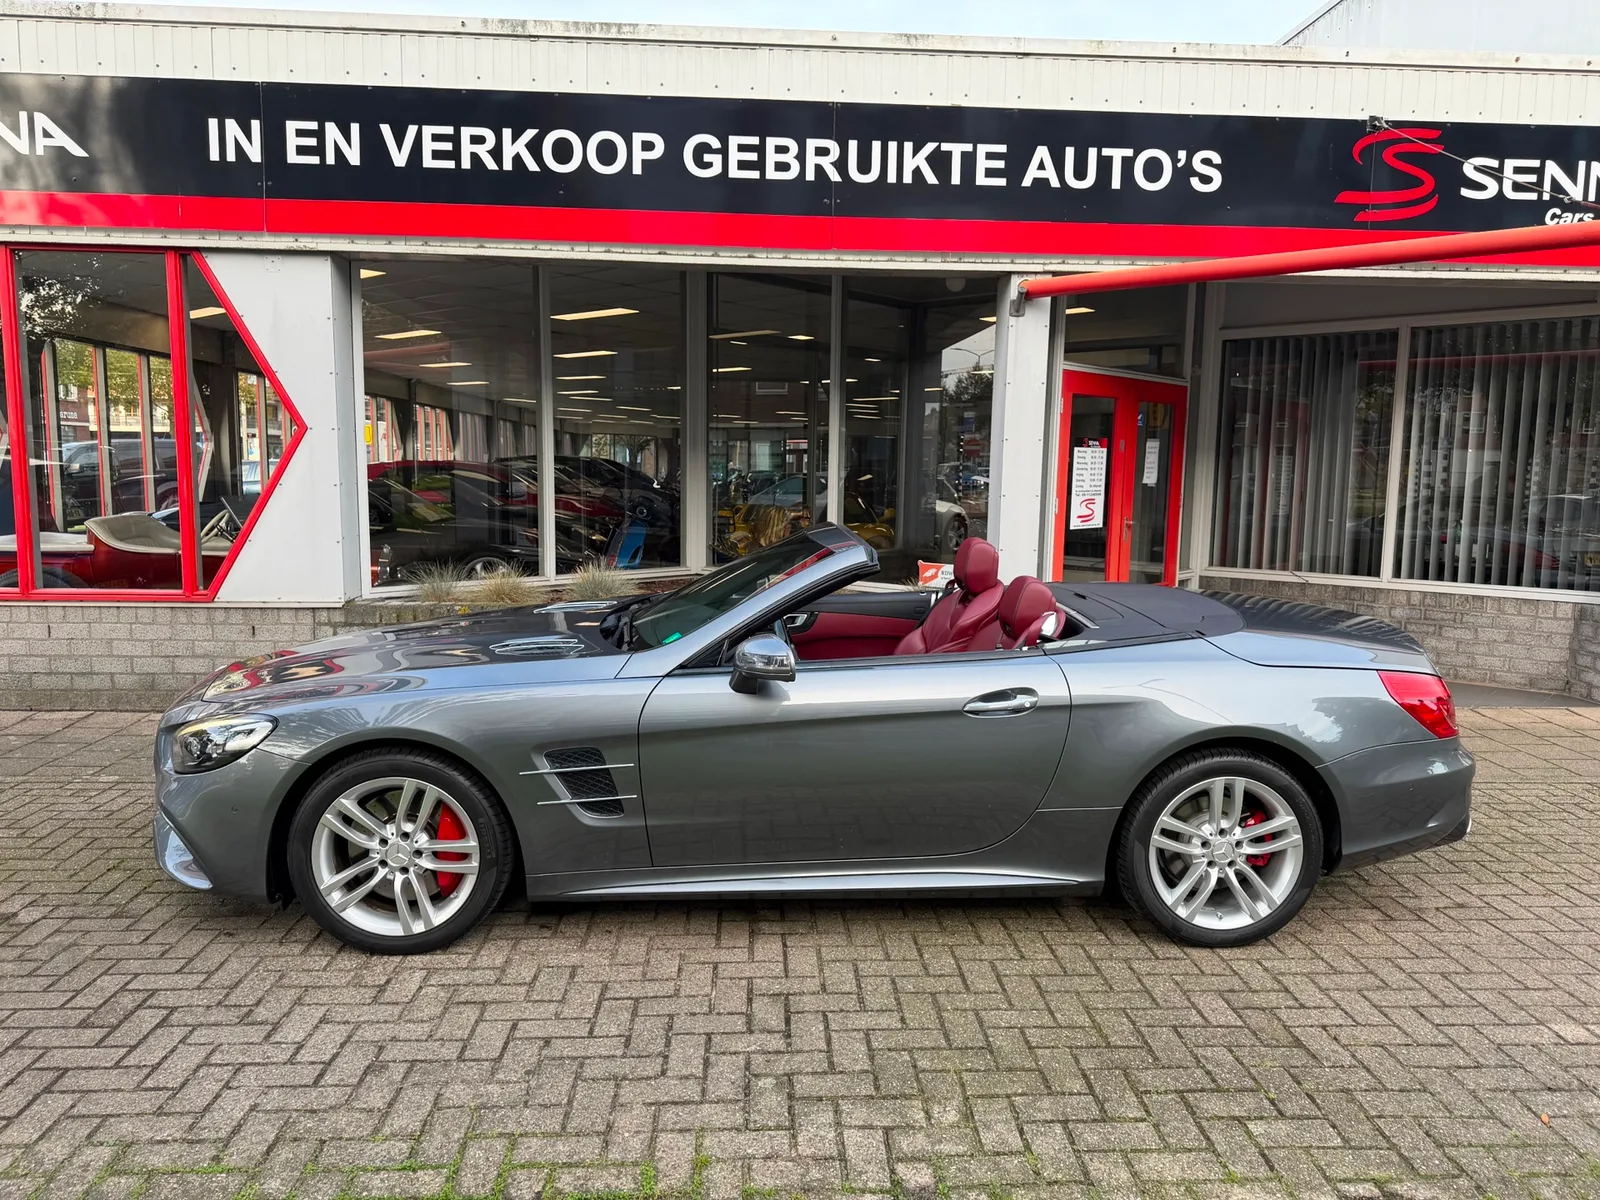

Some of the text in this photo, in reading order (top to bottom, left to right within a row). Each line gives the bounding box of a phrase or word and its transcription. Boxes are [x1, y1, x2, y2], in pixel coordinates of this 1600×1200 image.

[208, 118, 262, 163] IN
[285, 120, 361, 167] EN
[379, 123, 665, 176] VERKOOP
[683, 133, 1007, 187] GEBRUIKTE
[1460, 157, 1600, 202] SEN
